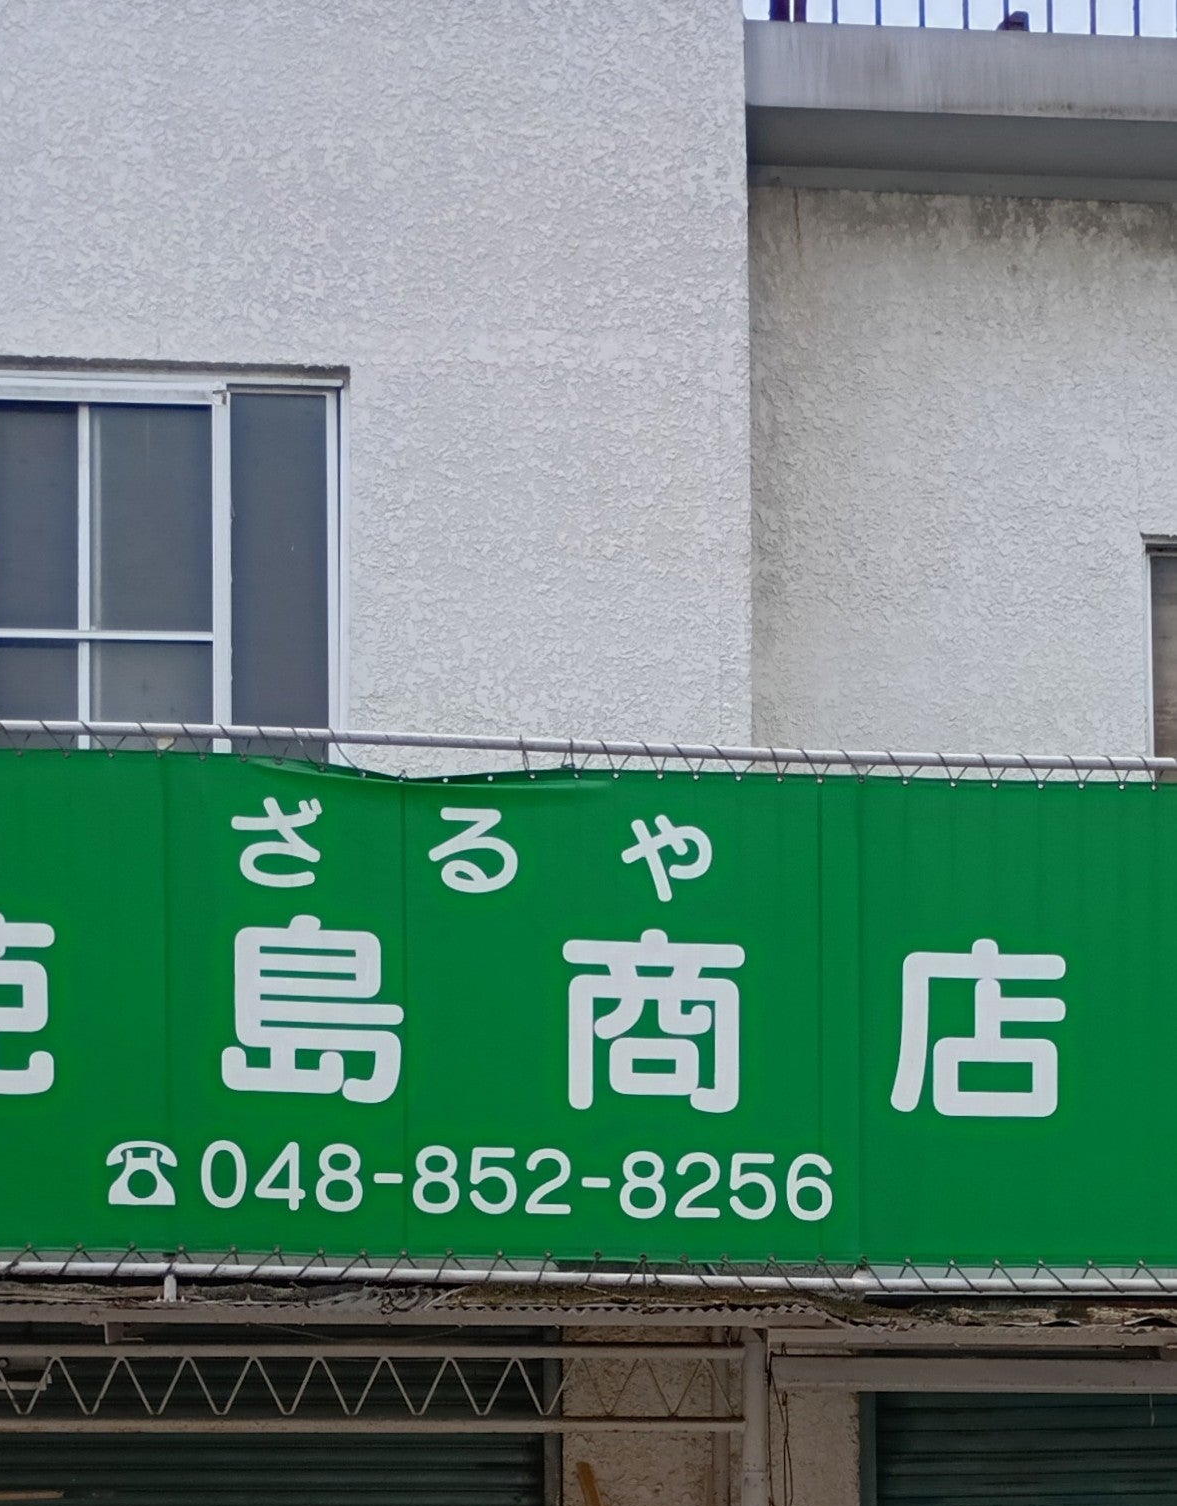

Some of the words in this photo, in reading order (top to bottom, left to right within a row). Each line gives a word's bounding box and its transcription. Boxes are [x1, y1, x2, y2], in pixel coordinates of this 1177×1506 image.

[230, 796, 713, 902] ざるや
[199, 1139, 833, 1221] 048-852-8256
